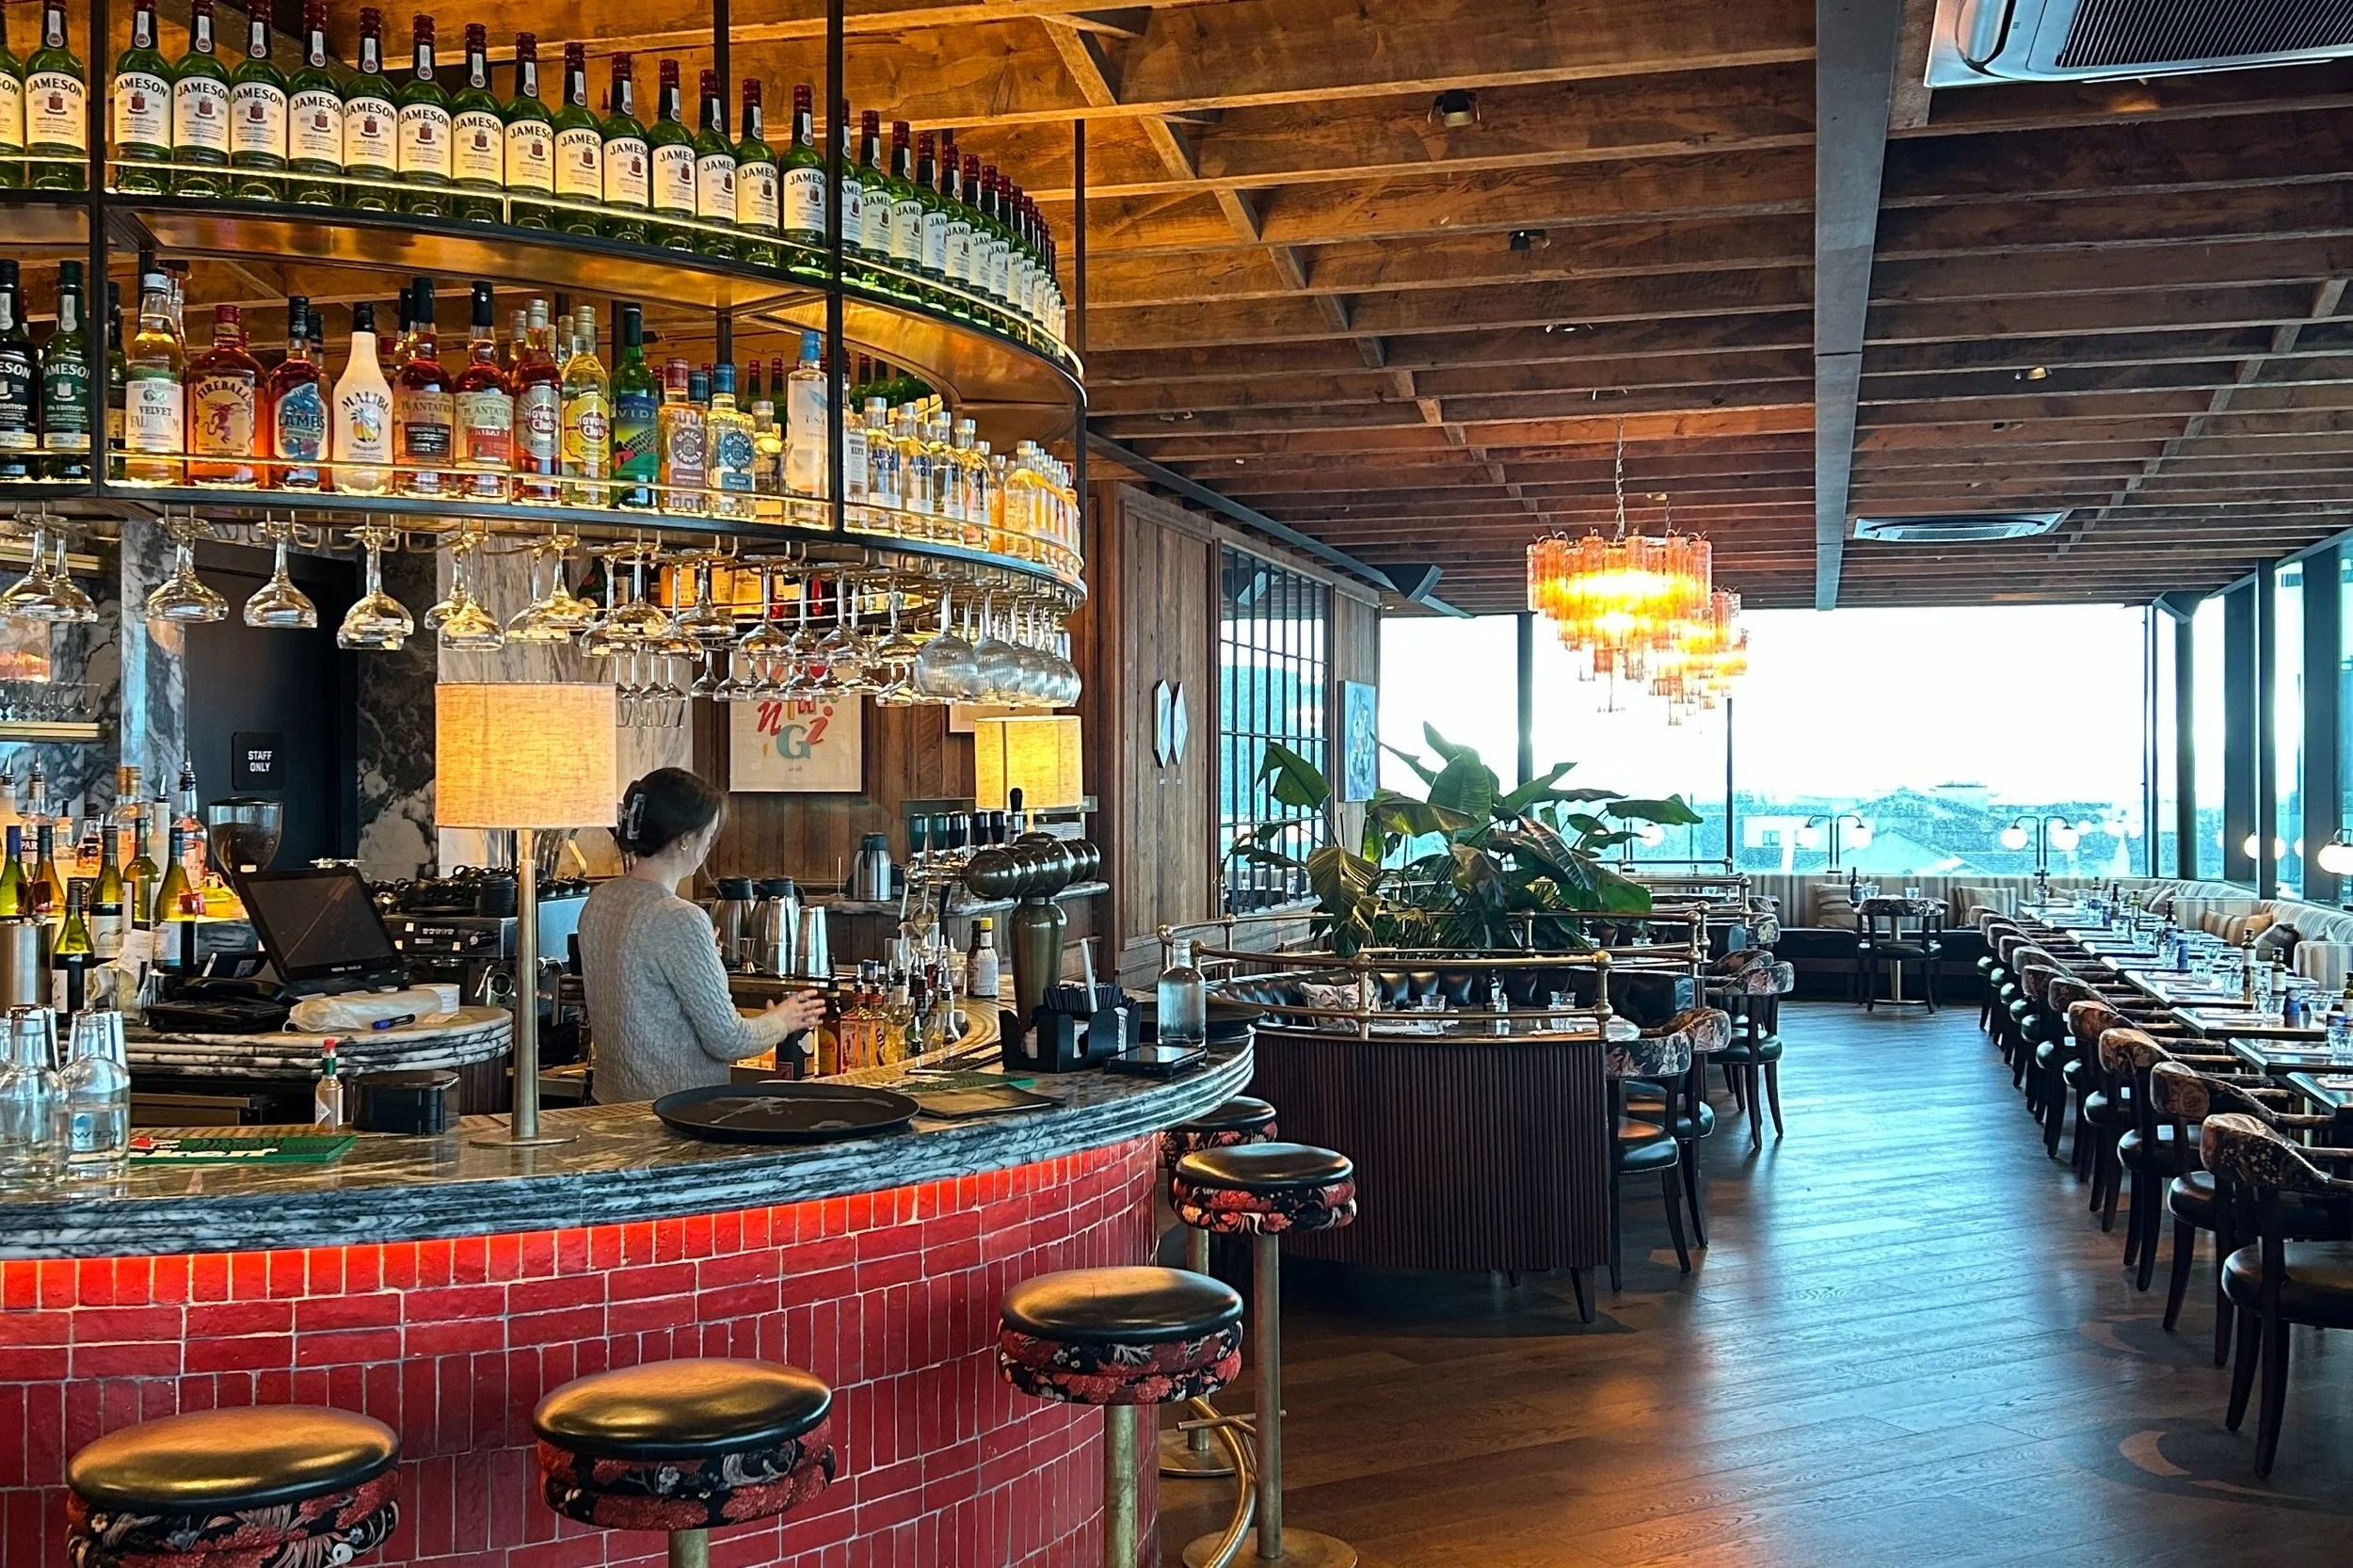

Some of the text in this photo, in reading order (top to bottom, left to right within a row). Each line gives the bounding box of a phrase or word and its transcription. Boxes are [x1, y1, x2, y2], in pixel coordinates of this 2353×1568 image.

[28, 78, 83, 98] JAMESON
[115, 77, 168, 97] JAMESON
[232, 88, 283, 107] JAMESON
[344, 102, 395, 121] JAMESON
[399, 109, 449, 129] JAMESON
[341, 391, 392, 415] MALIBU
[138, 406, 172, 417] VELVET
[532, 420, 554, 431] Club
[583, 424, 604, 437] Club
[676, 430, 702, 445] OLMECA
[677, 449, 703, 464] TEQUILA
[248, 750, 273, 760] STAFF
[249, 762, 271, 773] ONLY
